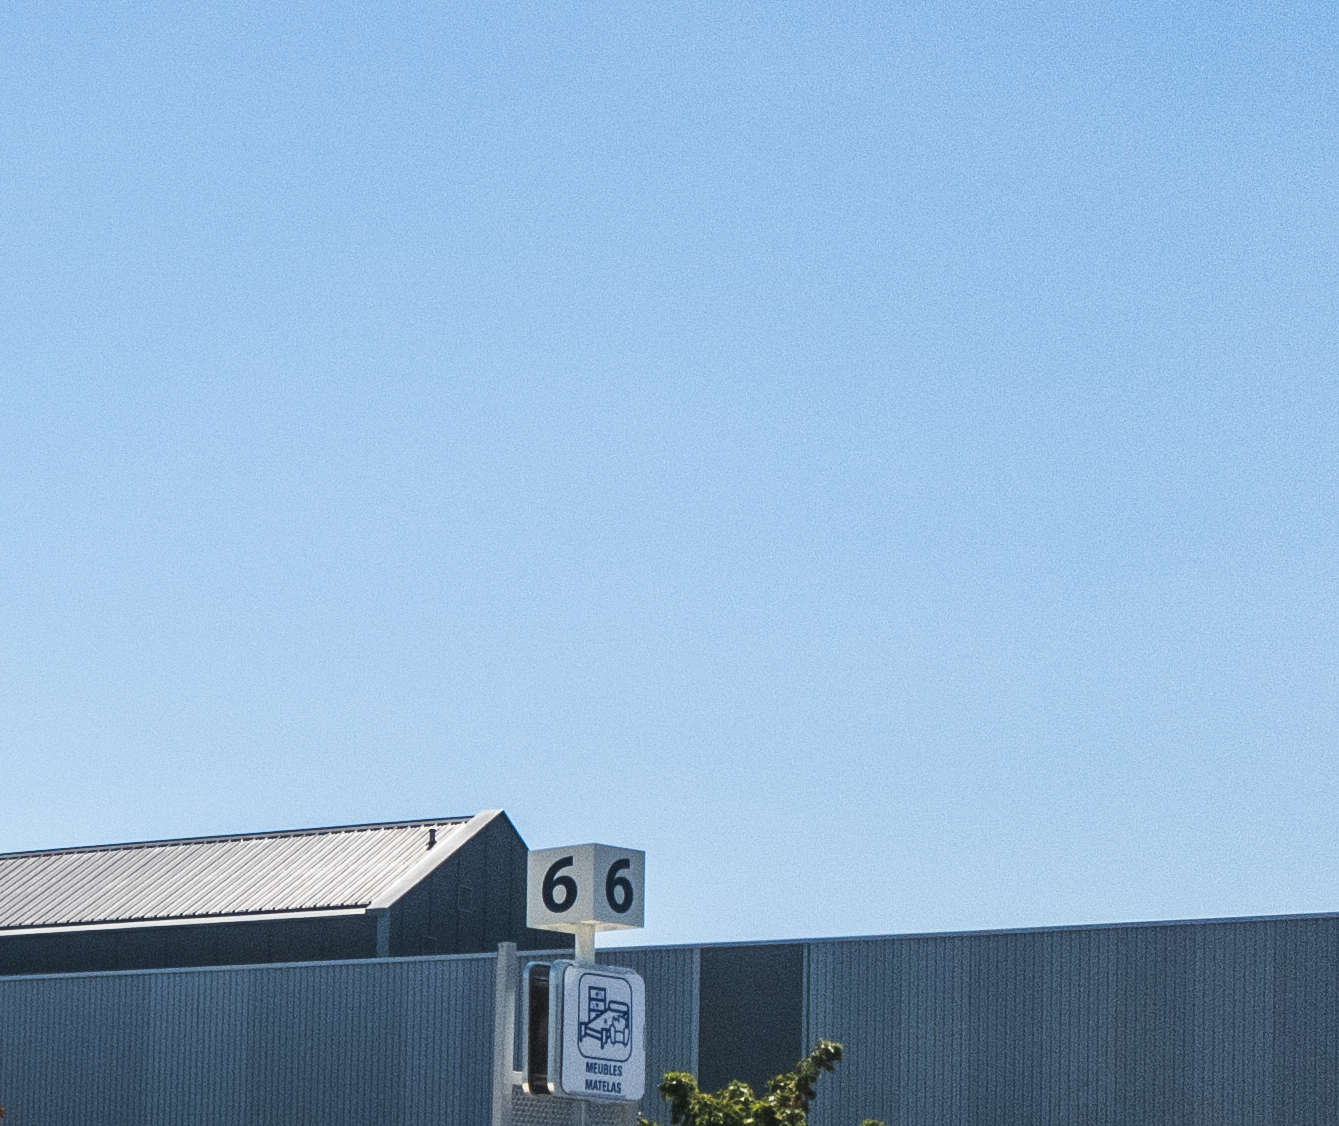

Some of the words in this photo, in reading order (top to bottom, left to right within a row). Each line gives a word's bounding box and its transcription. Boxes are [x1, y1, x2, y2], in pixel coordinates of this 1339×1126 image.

[542, 855, 578, 914] 6
[605, 858, 634, 914] 6
[584, 1079, 622, 1094] MATELAS
[585, 1061, 623, 1077] MEUBLES
